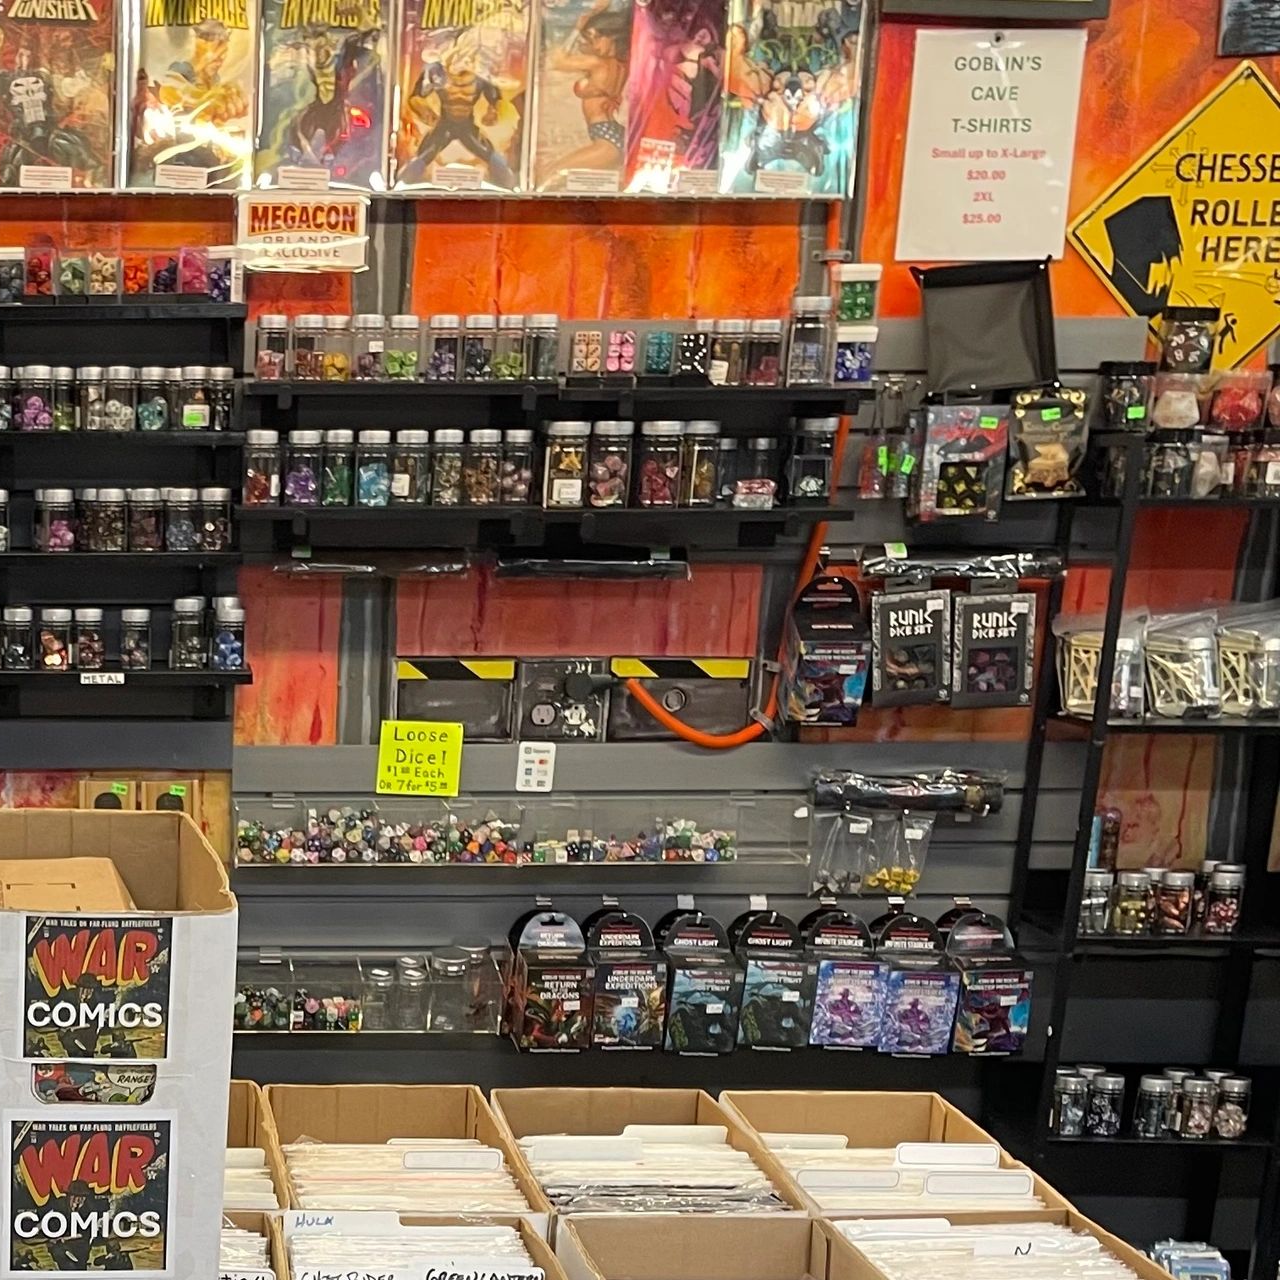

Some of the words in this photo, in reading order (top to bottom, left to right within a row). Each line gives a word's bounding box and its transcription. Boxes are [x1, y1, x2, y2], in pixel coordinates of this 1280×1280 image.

[971, 86, 1019, 101] CAVE
[952, 118, 1032, 133] T-SHIRTS
[931, 148, 966, 159] Small
[968, 151, 984, 160] up
[987, 148, 999, 158] to
[967, 170, 1007, 181] $20.00
[973, 192, 995, 202] 2XL
[250, 205, 357, 232] MEGACON
[889, 626, 909, 638] DICE
[910, 623, 933, 636] SET
[972, 627, 995, 640] DICE
[997, 625, 1017, 638] SET
[82, 674, 122, 684] METAL
[394, 727, 448, 742] Loose
[396, 749, 446, 765] Dice!
[415, 767, 444, 778] Each
[698, 939, 719, 947] LIGHT
[33, 929, 159, 998] WAR
[544, 981, 577, 989] RETURN
[27, 1002, 163, 1029] COMICS
[117, 1075, 154, 1084] RANGE!
[20, 1132, 156, 1207] WAR
[14, 1211, 161, 1239] COMICS
[295, 1215, 335, 1228] HULK
